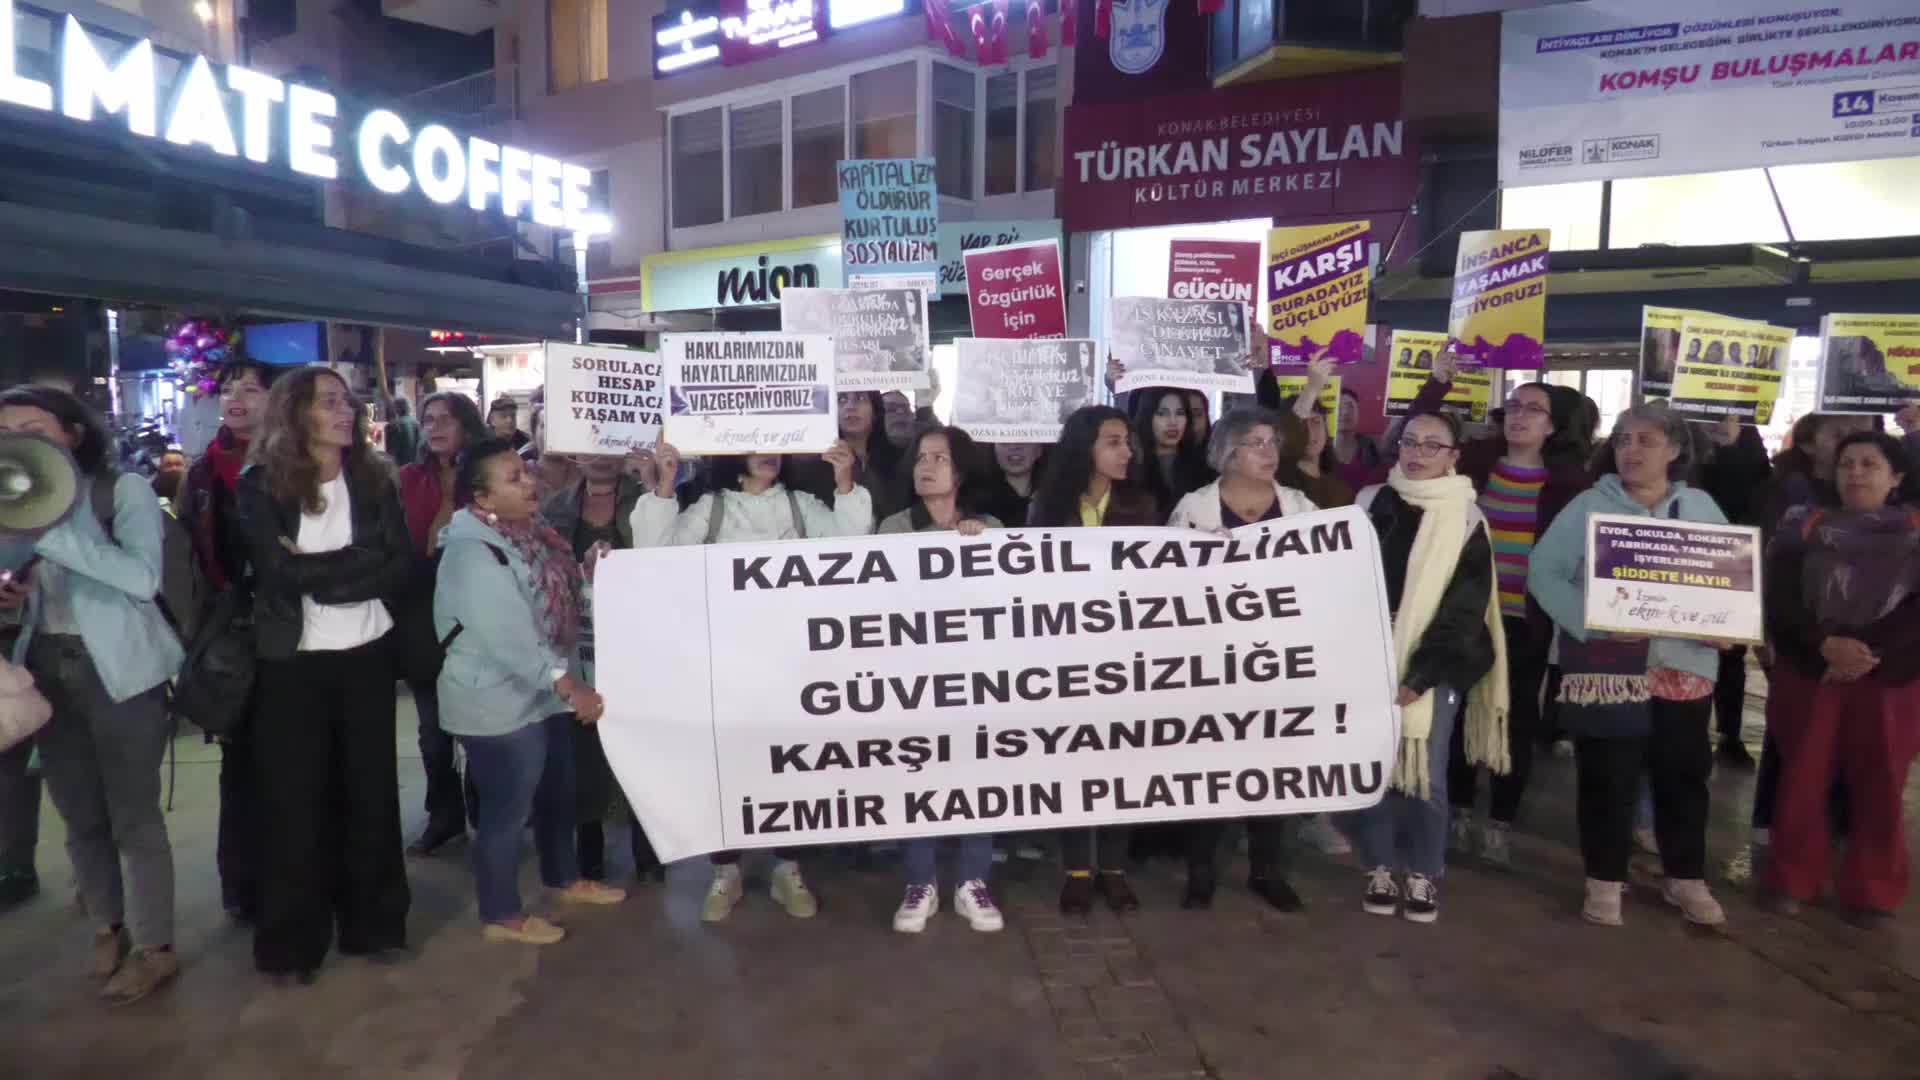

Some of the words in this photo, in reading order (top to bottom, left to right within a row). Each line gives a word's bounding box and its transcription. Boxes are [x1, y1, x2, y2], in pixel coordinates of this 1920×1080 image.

[1600, 64, 1702, 93] KOMŞU
[1838, 95, 1869, 114] 14
[1157, 119, 1215, 137] KONAK
[1074, 138, 1230, 183] TÜRKAN
[1239, 120, 1403, 169] SAYLAN
[1612, 138, 1656, 151] KONAK
[358, 108, 598, 232] COFFEE
[840, 161, 935, 190] KAPİTALİZM
[857, 187, 931, 211] ÖLDÜRÜR
[1135, 179, 1224, 204] KÜLTÜR
[1231, 168, 1342, 196] MERKEZİ
[844, 216, 936, 240] KURTULUŞ
[846, 239, 938, 264] SOSYALİZM
[1462, 234, 1541, 271] İNSANCA
[982, 261, 1043, 283] Gerçek
[1274, 240, 1363, 291] KARŞI
[1457, 256, 1544, 295] YAŞAMAK
[978, 284, 1056, 308] Özgürlük
[1173, 277, 1252, 300] GÜCÜN
[1272, 273, 1363, 315] BURADAYIZ
[1452, 282, 1543, 320] İSTİYORUZ!
[1003, 312, 1036, 331] için
[1273, 288, 1368, 331] GÜÇLÜYÜZ!
[685, 341, 804, 360] HAKLARIMIZDAN
[598, 375, 656, 392] HESAP
[681, 364, 817, 383] HAYATLARIMIZDAN
[689, 387, 811, 415] VAZGEÇMİYORUZ
[572, 407, 636, 423] YAŞAM
[1600, 527, 1633, 537] EVDE,
[1636, 530, 1685, 541] OKULDA,
[733, 551, 896, 591] KAZA
[918, 541, 1091, 580] DEĞİL
[1112, 521, 1353, 571] KATLİAM
[1611, 540, 1679, 553] FABRİKADA,
[1682, 545, 1736, 559] TARLADA,
[1612, 565, 1679, 583] ŞİDDETE
[1683, 573, 1732, 588] HAYIR
[807, 584, 1301, 651] DENETİMSİZLİĞE
[800, 642, 1317, 716] GÜVENCESİZLİĞE
[770, 735, 951, 773] KARŞI
[976, 706, 1315, 760] İSYANDAYIZ
[1335, 703, 1347, 734] !
[743, 790, 887, 835] İZMİR
[904, 780, 1062, 824] KADIN
[1081, 761, 1383, 812] PLATFORMU
